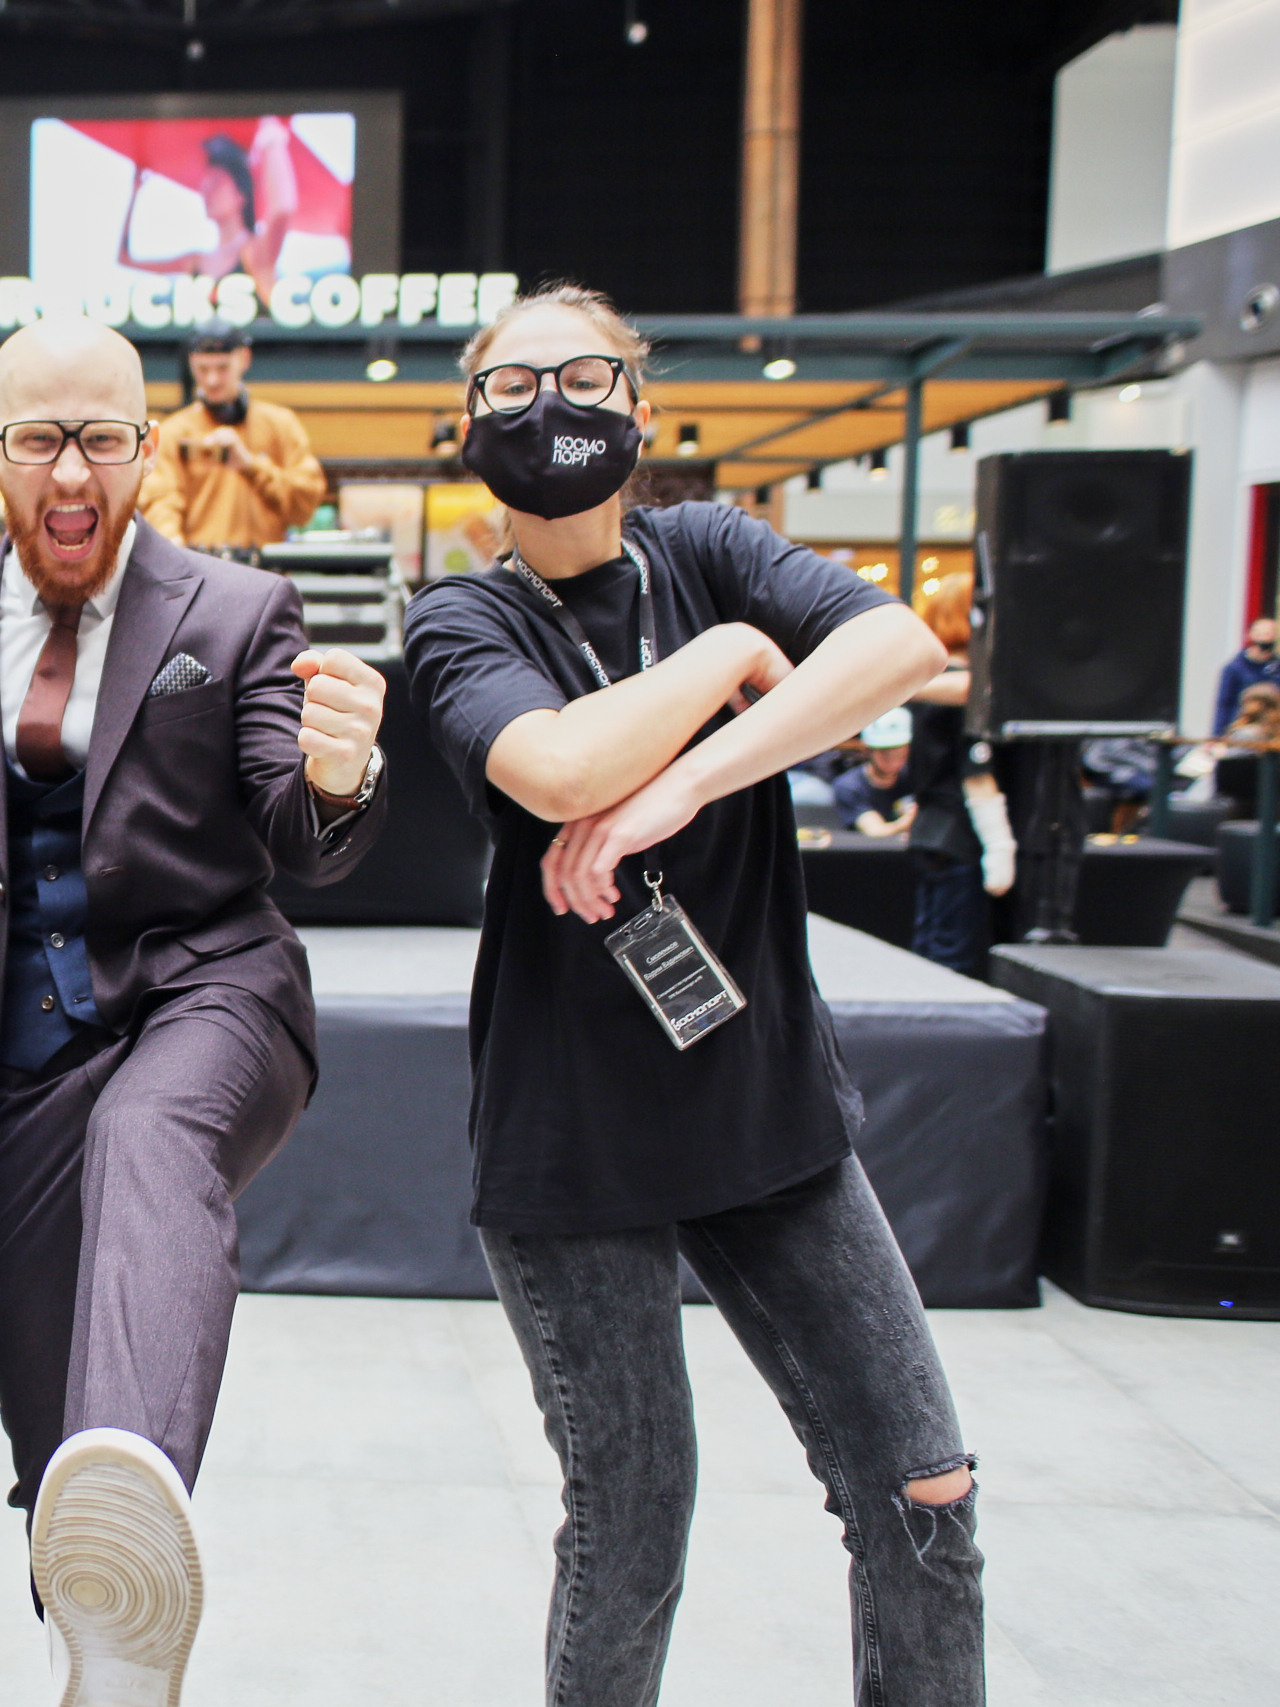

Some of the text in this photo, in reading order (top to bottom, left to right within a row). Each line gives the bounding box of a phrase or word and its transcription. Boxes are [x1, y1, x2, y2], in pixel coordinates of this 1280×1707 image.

[270, 273, 519, 327] COFFEE
[552, 449, 591, 467] ПОРТ
[554, 435, 607, 455] КОСМО
[516, 558, 563, 607] КОСМОПОРТ
[581, 641, 611, 687] КОСМОП
